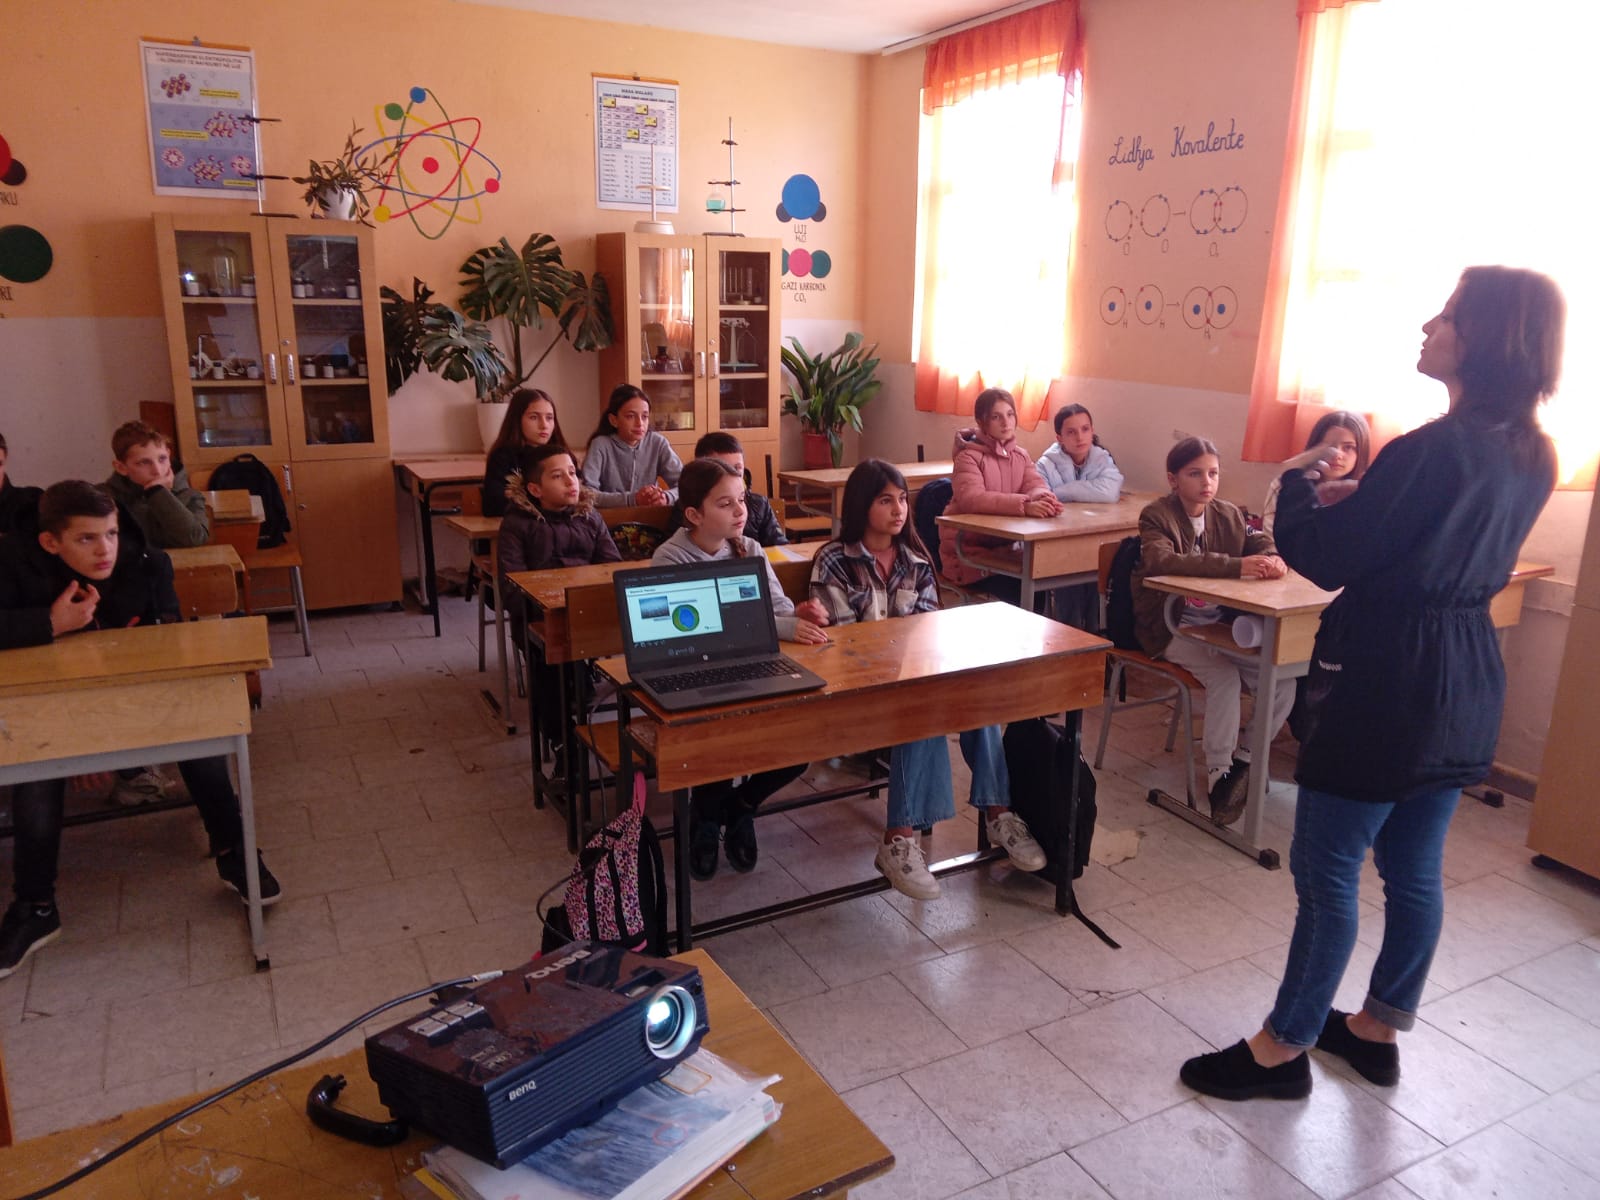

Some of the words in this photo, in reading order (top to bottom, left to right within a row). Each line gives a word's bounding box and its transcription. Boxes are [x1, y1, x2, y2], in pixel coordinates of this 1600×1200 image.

[1108, 135, 1156, 171] Lidhja
[1170, 118, 1245, 158] Kovalente
[794, 223, 807, 235] UJI
[508, 1079, 537, 1101] BenQ
